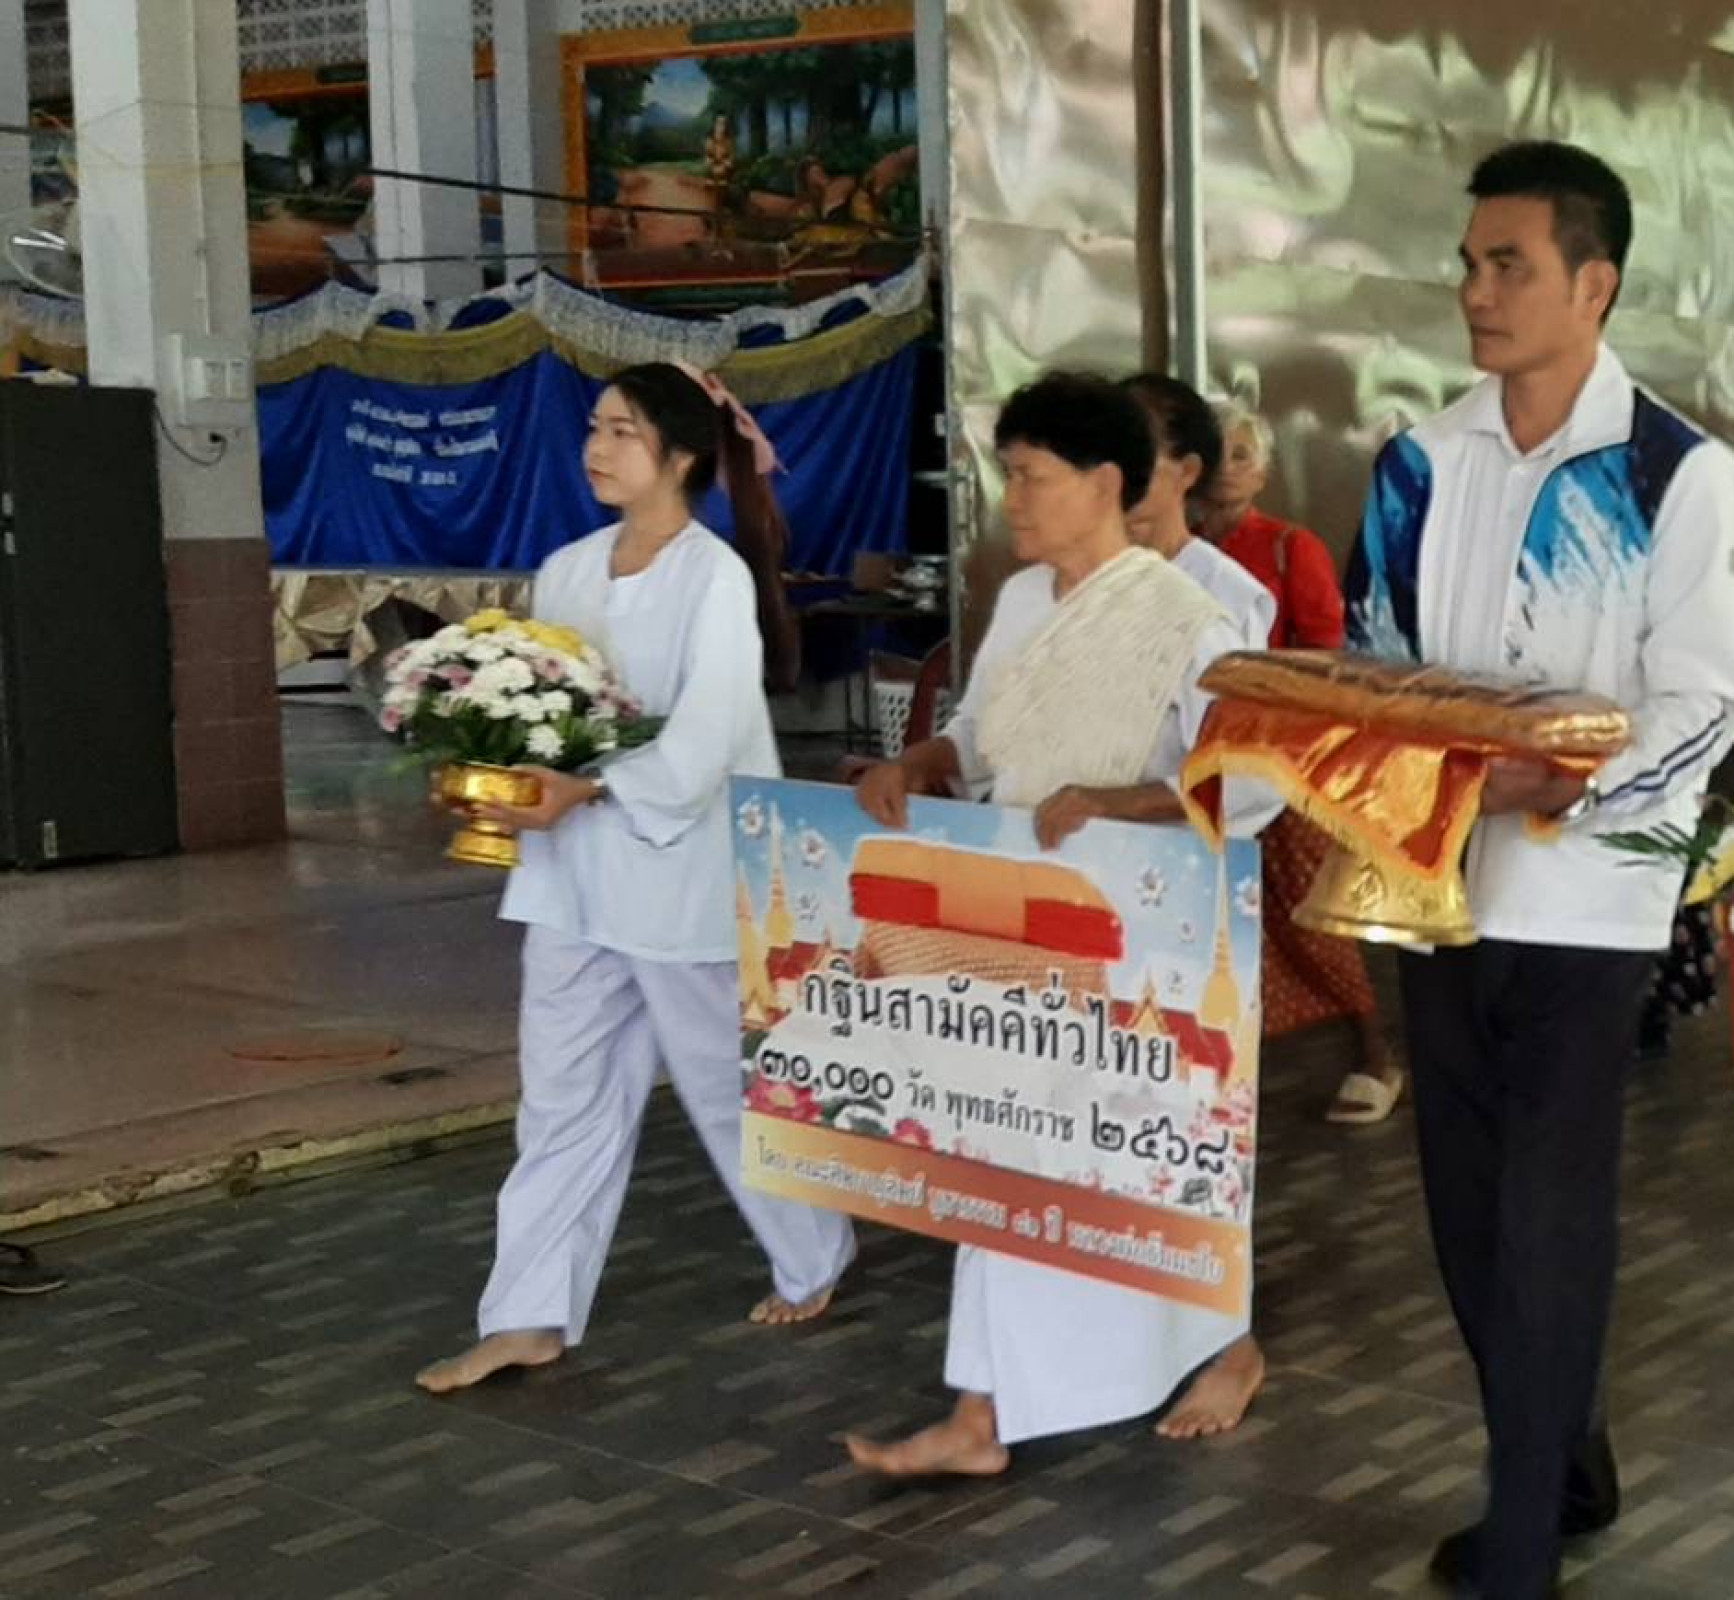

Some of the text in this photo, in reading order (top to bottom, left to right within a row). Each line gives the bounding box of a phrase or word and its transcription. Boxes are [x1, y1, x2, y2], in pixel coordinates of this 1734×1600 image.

[804, 958, 1172, 1082] กฐินสามัคคีทั่วไทย
[761, 1049, 1230, 1174] ๓๐,๐๐๐ วัด พุทธศักราช ๒๕๖๘
